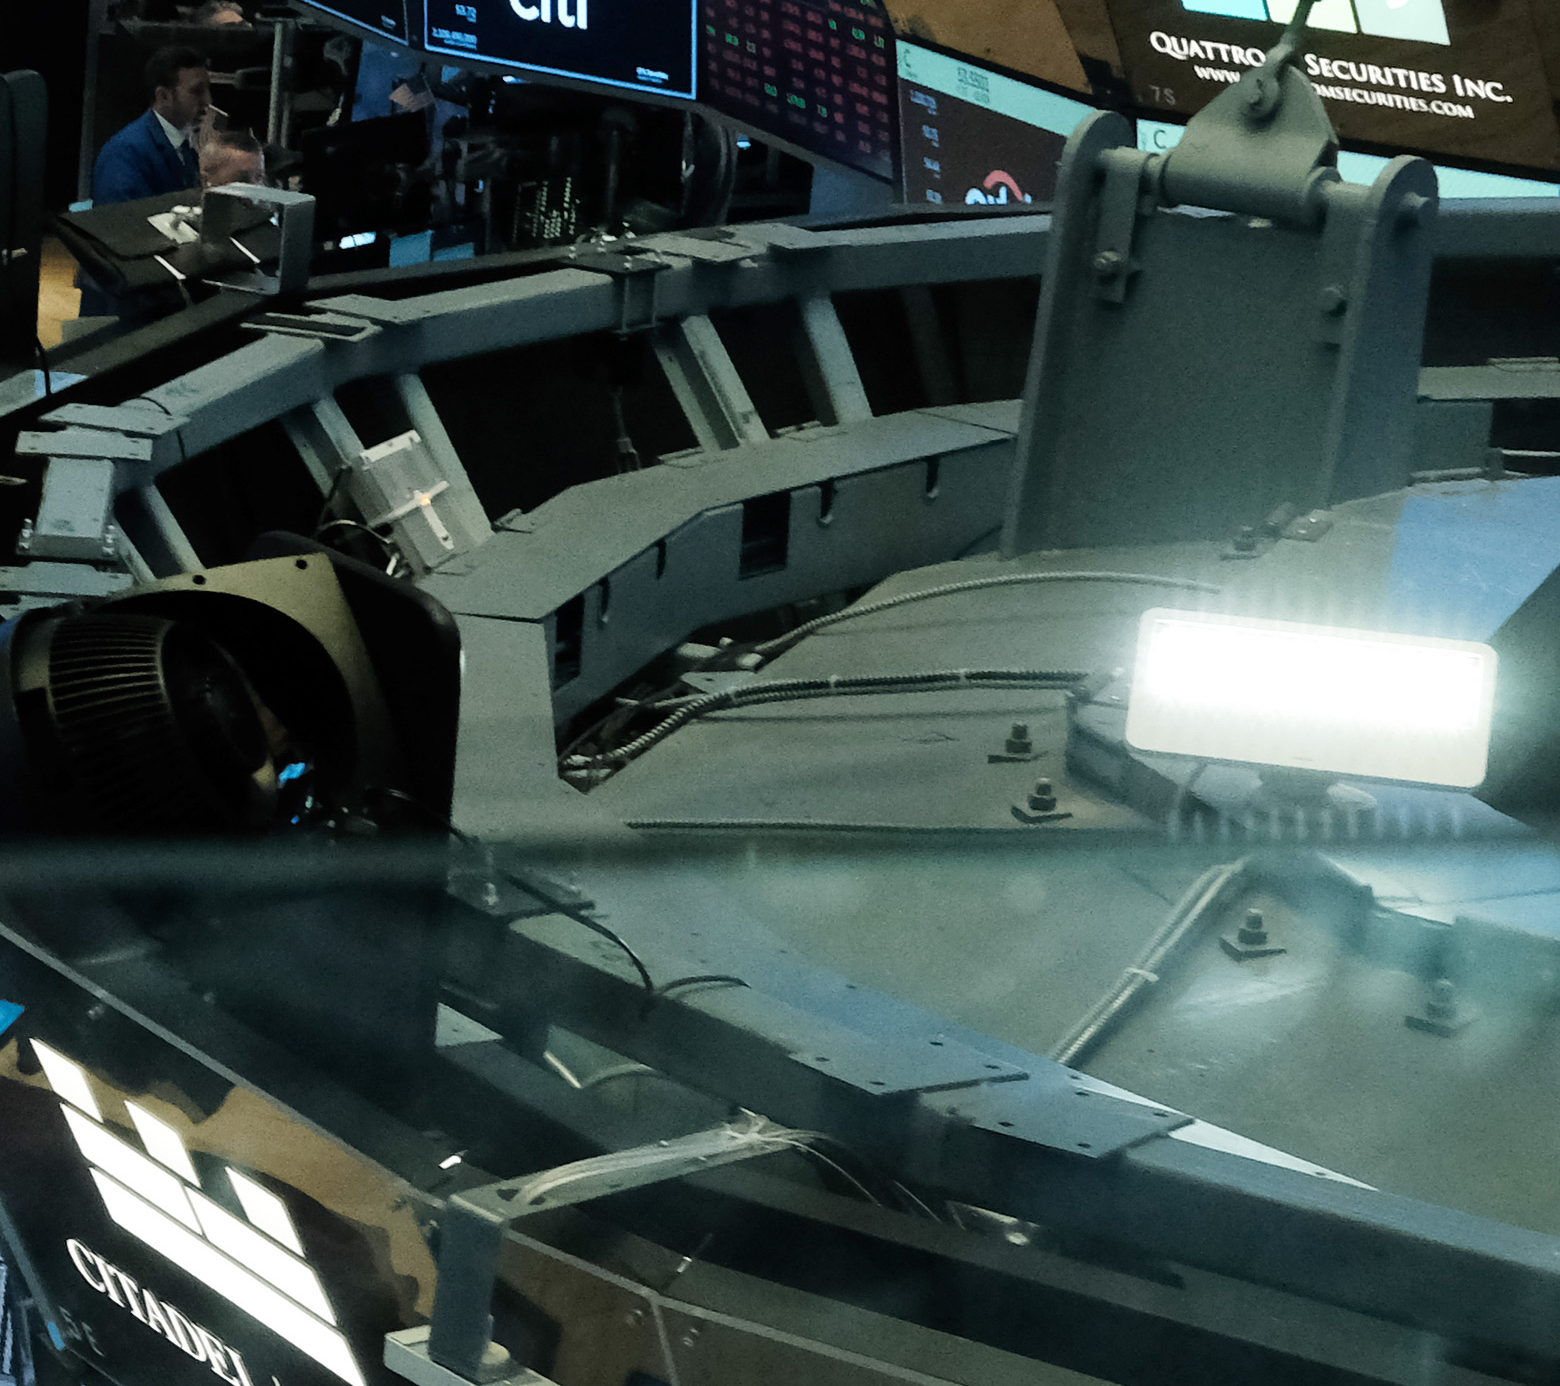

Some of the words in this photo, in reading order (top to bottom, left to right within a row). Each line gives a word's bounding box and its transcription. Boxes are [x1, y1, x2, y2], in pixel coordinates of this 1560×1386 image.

[1150, 32, 1266, 67] QUATTRO
[1305, 54, 1445, 94] SECURITIES
[1453, 73, 1513, 103] INC.
